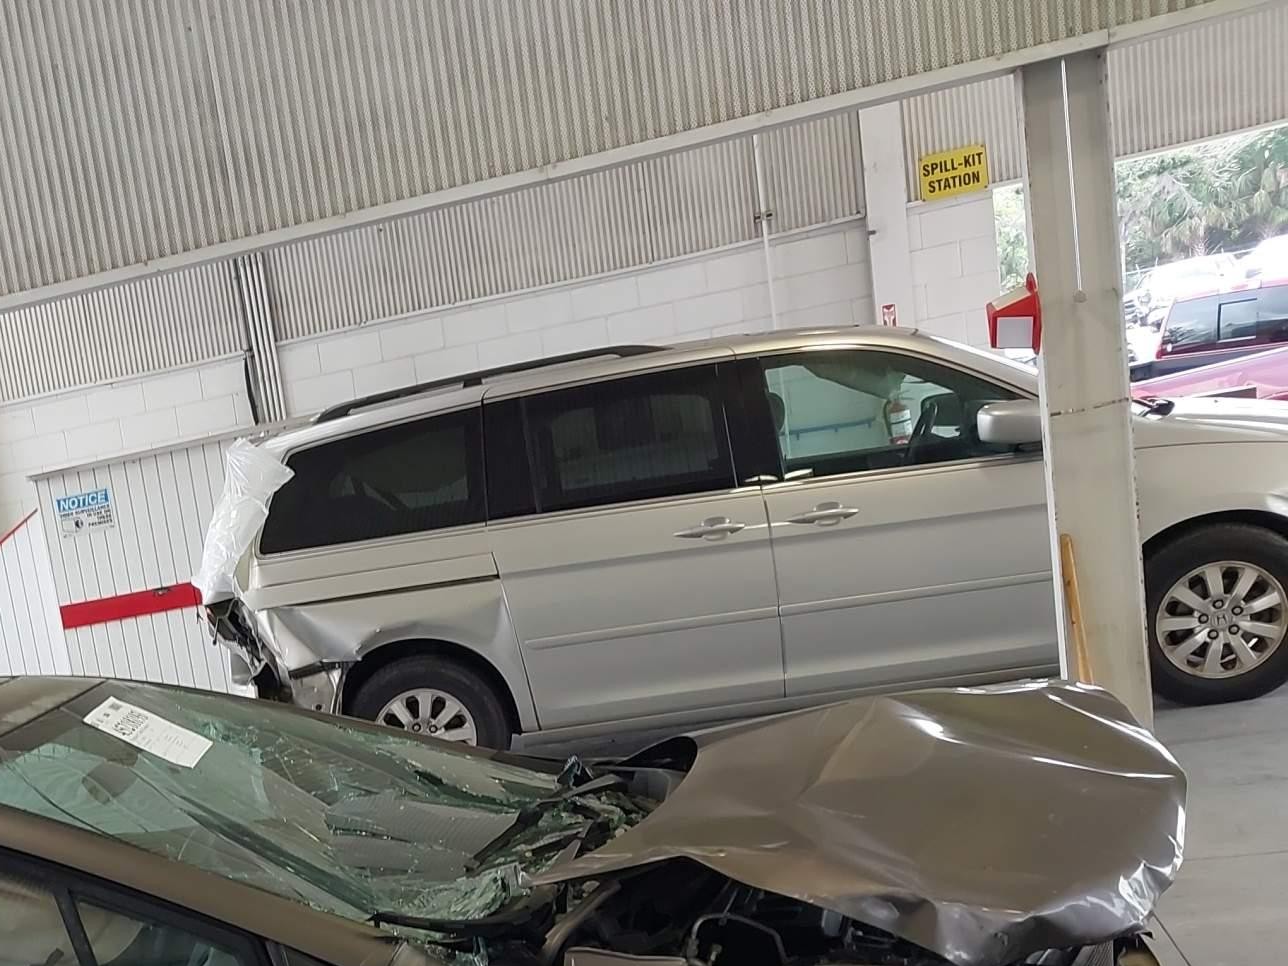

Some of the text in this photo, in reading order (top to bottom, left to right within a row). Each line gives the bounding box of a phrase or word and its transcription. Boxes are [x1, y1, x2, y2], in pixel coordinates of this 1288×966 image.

[922, 152, 983, 177] SPILL-KIT
[928, 170, 980, 193] STATION
[60, 491, 106, 511] NOTICE
